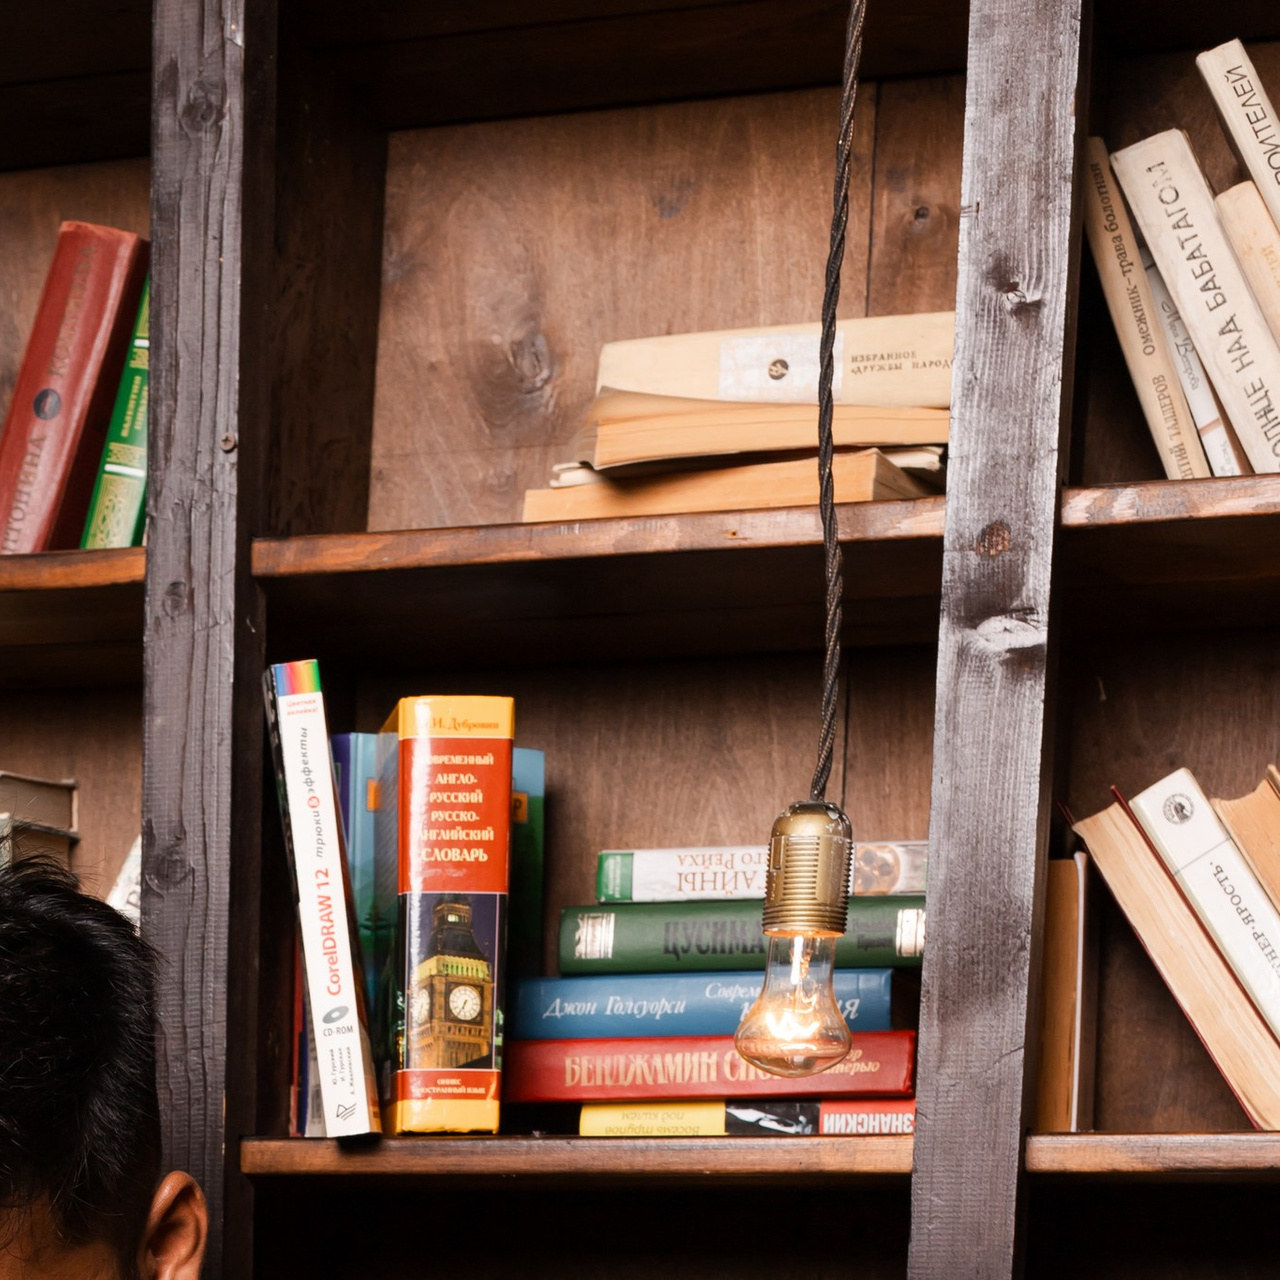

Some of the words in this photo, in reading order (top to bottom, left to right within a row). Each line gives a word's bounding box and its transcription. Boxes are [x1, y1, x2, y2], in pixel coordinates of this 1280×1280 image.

[1090, 162, 1119, 233] болотная
[1218, 313, 1255, 374] НАД
[850, 351, 917, 364] ИЗБРАННОЕ
[0, 434, 46, 552] НТОНИНА
[448, 717, 499, 731] Дубровин
[300, 727, 316, 794] эффекты
[422, 753, 494, 766] ОВРЕМЕННЫЙ
[434, 773, 478, 785] АНГЛО-
[429, 788, 483, 804] РУССКИЙ
[430, 810, 480, 822] РУССКО-
[313, 810, 327, 858] трюки
[421, 848, 489, 863] СЛОВАРЬ
[315, 867, 330, 889] 12
[318, 894, 342, 996] CorelDRAW
[663, 919, 768, 961] ЦУСИМА
[541, 997, 598, 1021] Джон
[603, 997, 688, 1021] Голсуорси
[322, 1025, 354, 1038] CD-ROM
[564, 1049, 718, 1087] БЕНДЖАМИН
[822, 1060, 881, 1077] атерью
